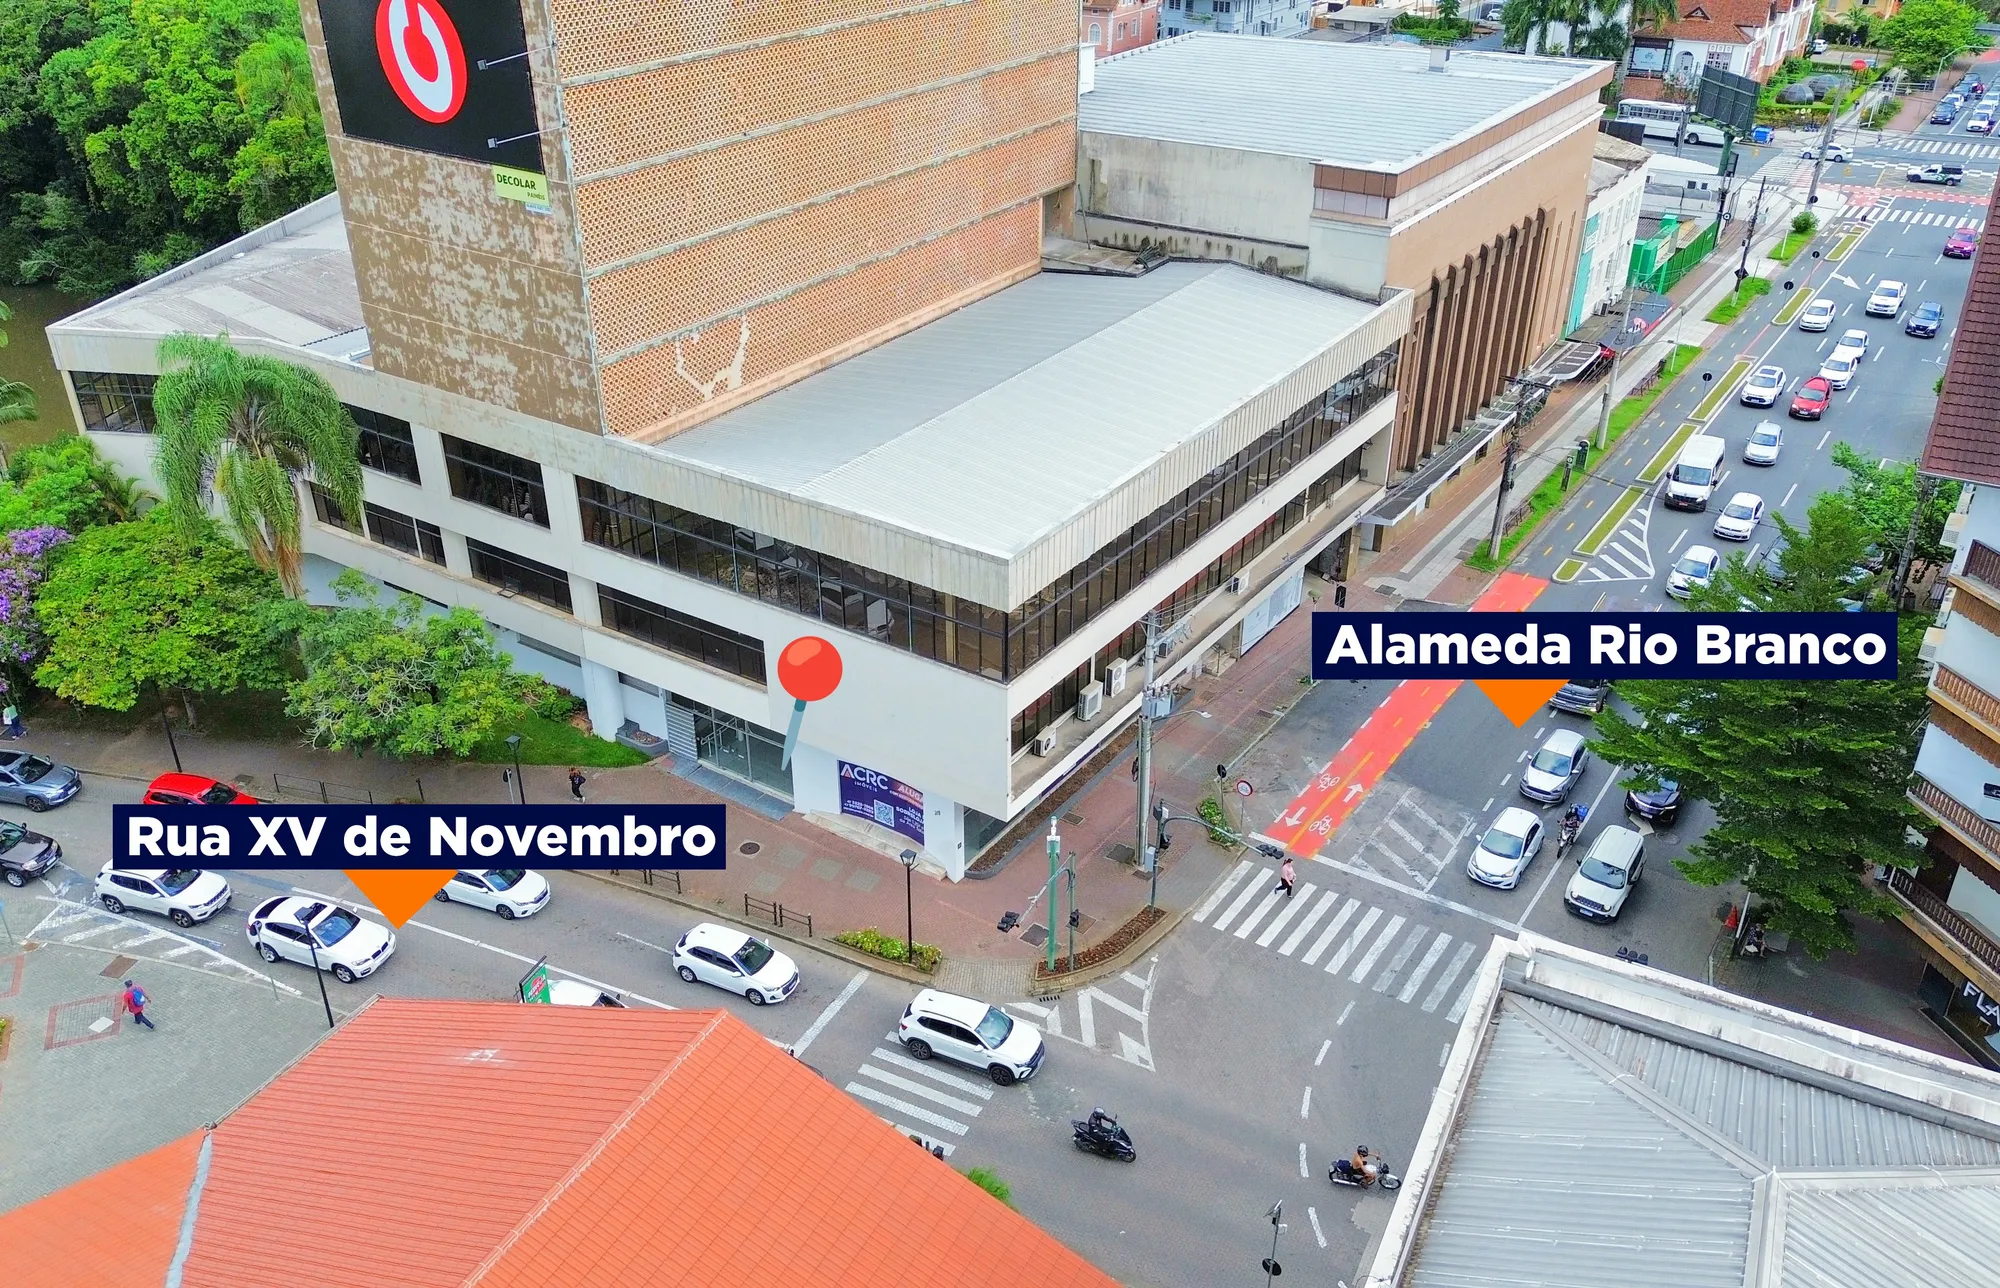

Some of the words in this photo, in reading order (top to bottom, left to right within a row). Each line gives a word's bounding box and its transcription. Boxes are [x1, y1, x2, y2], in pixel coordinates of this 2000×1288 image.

[497, 173, 536, 189] DECOLAR
[841, 764, 888, 790] ACRC
[854, 781, 878, 792] IMÓVEIS
[1963, 981, 2000, 1026] FLA
